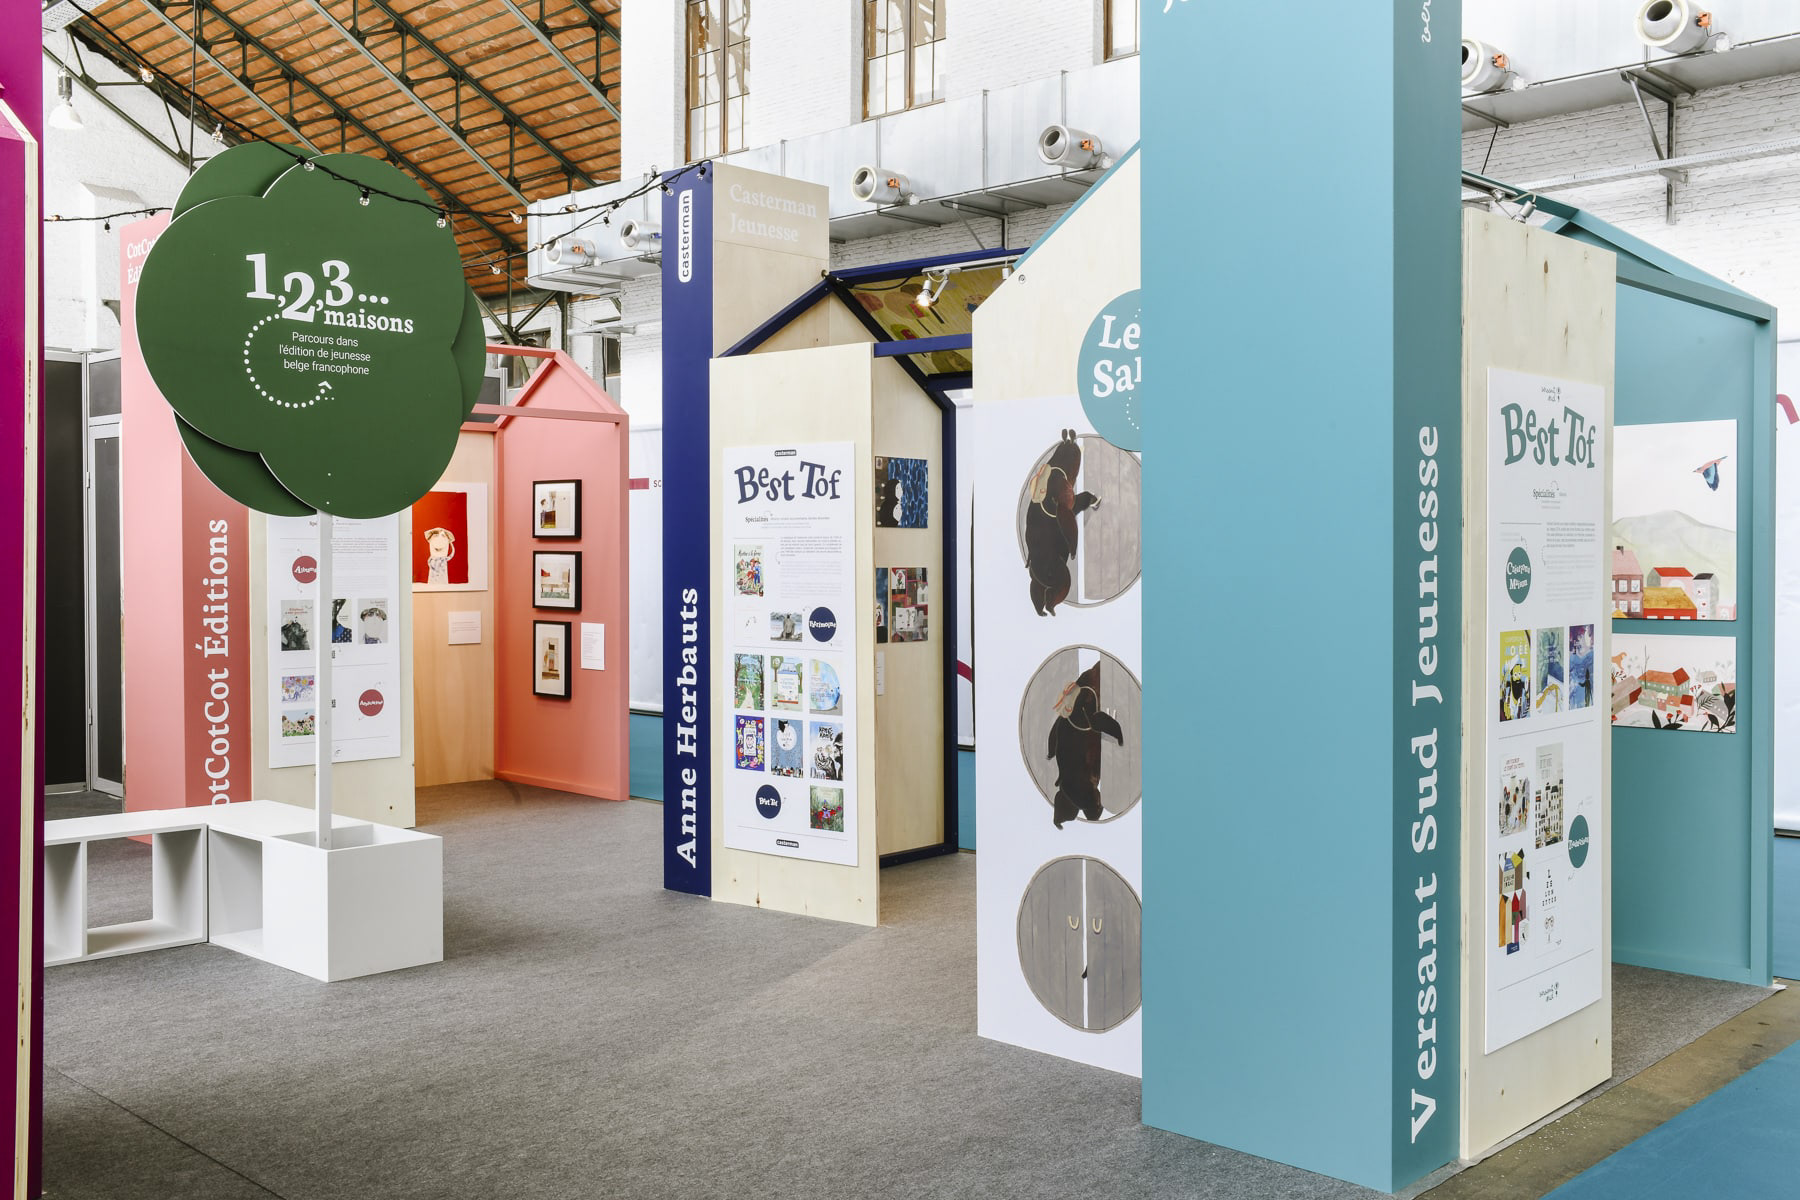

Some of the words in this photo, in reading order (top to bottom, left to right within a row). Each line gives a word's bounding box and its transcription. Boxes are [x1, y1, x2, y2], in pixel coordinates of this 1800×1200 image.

[730, 184, 817, 218] Casterman
[730, 212, 799, 242] Jeunesse
[681, 195, 690, 278] casterman
[279, 344, 315, 358] l'édition
[317, 347, 329, 358] de
[330, 348, 371, 362] jeunesse
[292, 331, 334, 345] Parcours
[336, 335, 359, 347] dans
[324, 308, 414, 334] maisons
[283, 358, 310, 372] belge
[312, 360, 370, 375] francophone
[1501, 403, 1559, 467] Best
[1563, 406, 1596, 469] Tof
[734, 465, 795, 504] Best
[799, 460, 842, 500] Tof
[195, 519, 229, 658] Éditions
[1412, 426, 1443, 707] Jeunesse
[676, 588, 697, 757] Herbauts
[676, 767, 697, 868] Anne
[1411, 728, 1438, 853] Sud
[1412, 872, 1438, 1144] Versant
